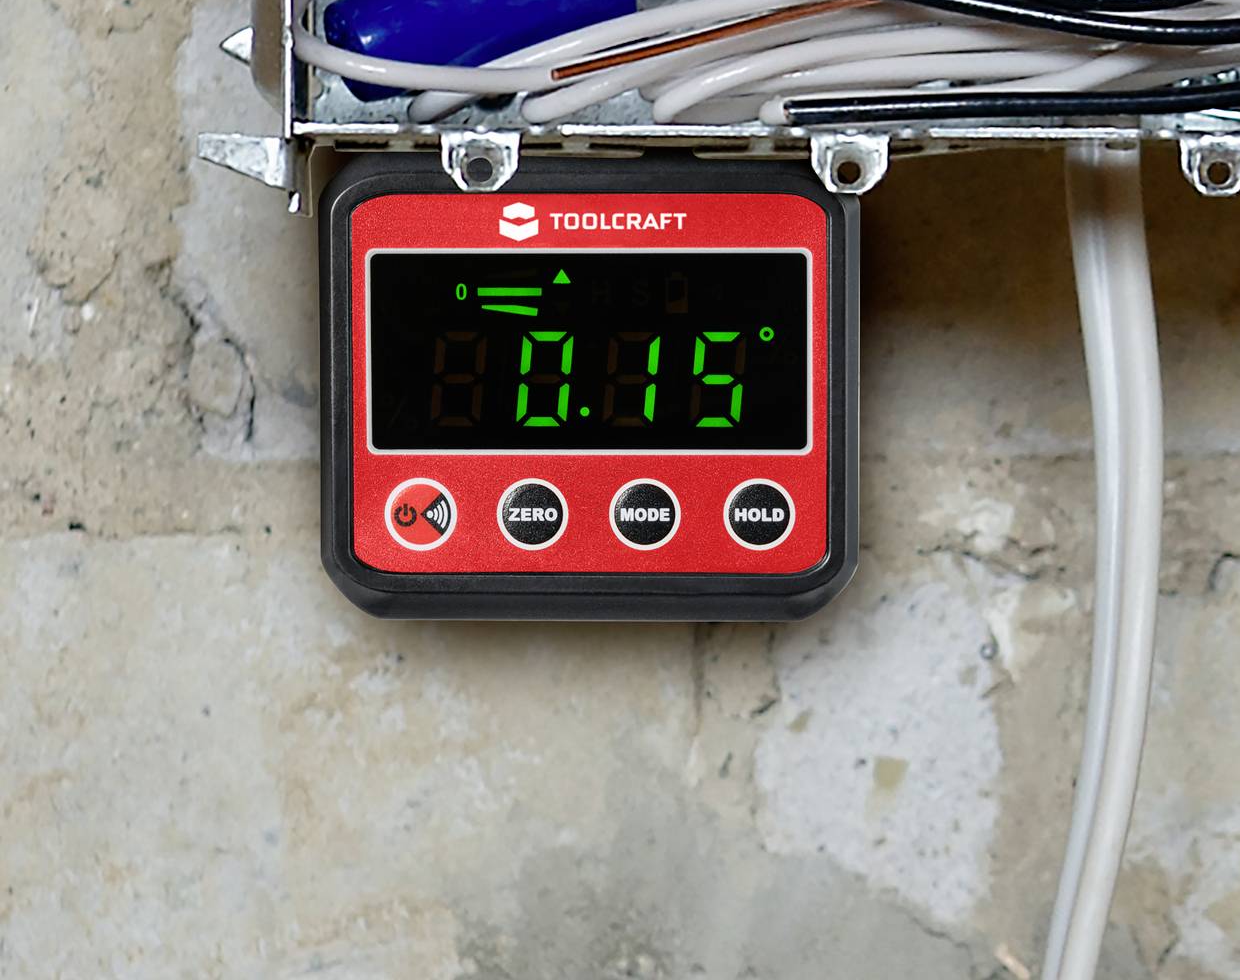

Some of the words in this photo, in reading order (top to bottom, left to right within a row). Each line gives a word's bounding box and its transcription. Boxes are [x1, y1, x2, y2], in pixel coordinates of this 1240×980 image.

[550, 213, 687, 230] TOOLCRAFT
[455, 283, 468, 301] 0
[508, 507, 558, 522] ZERO
[620, 507, 671, 522] MODE
[734, 507, 785, 522] HOLD
